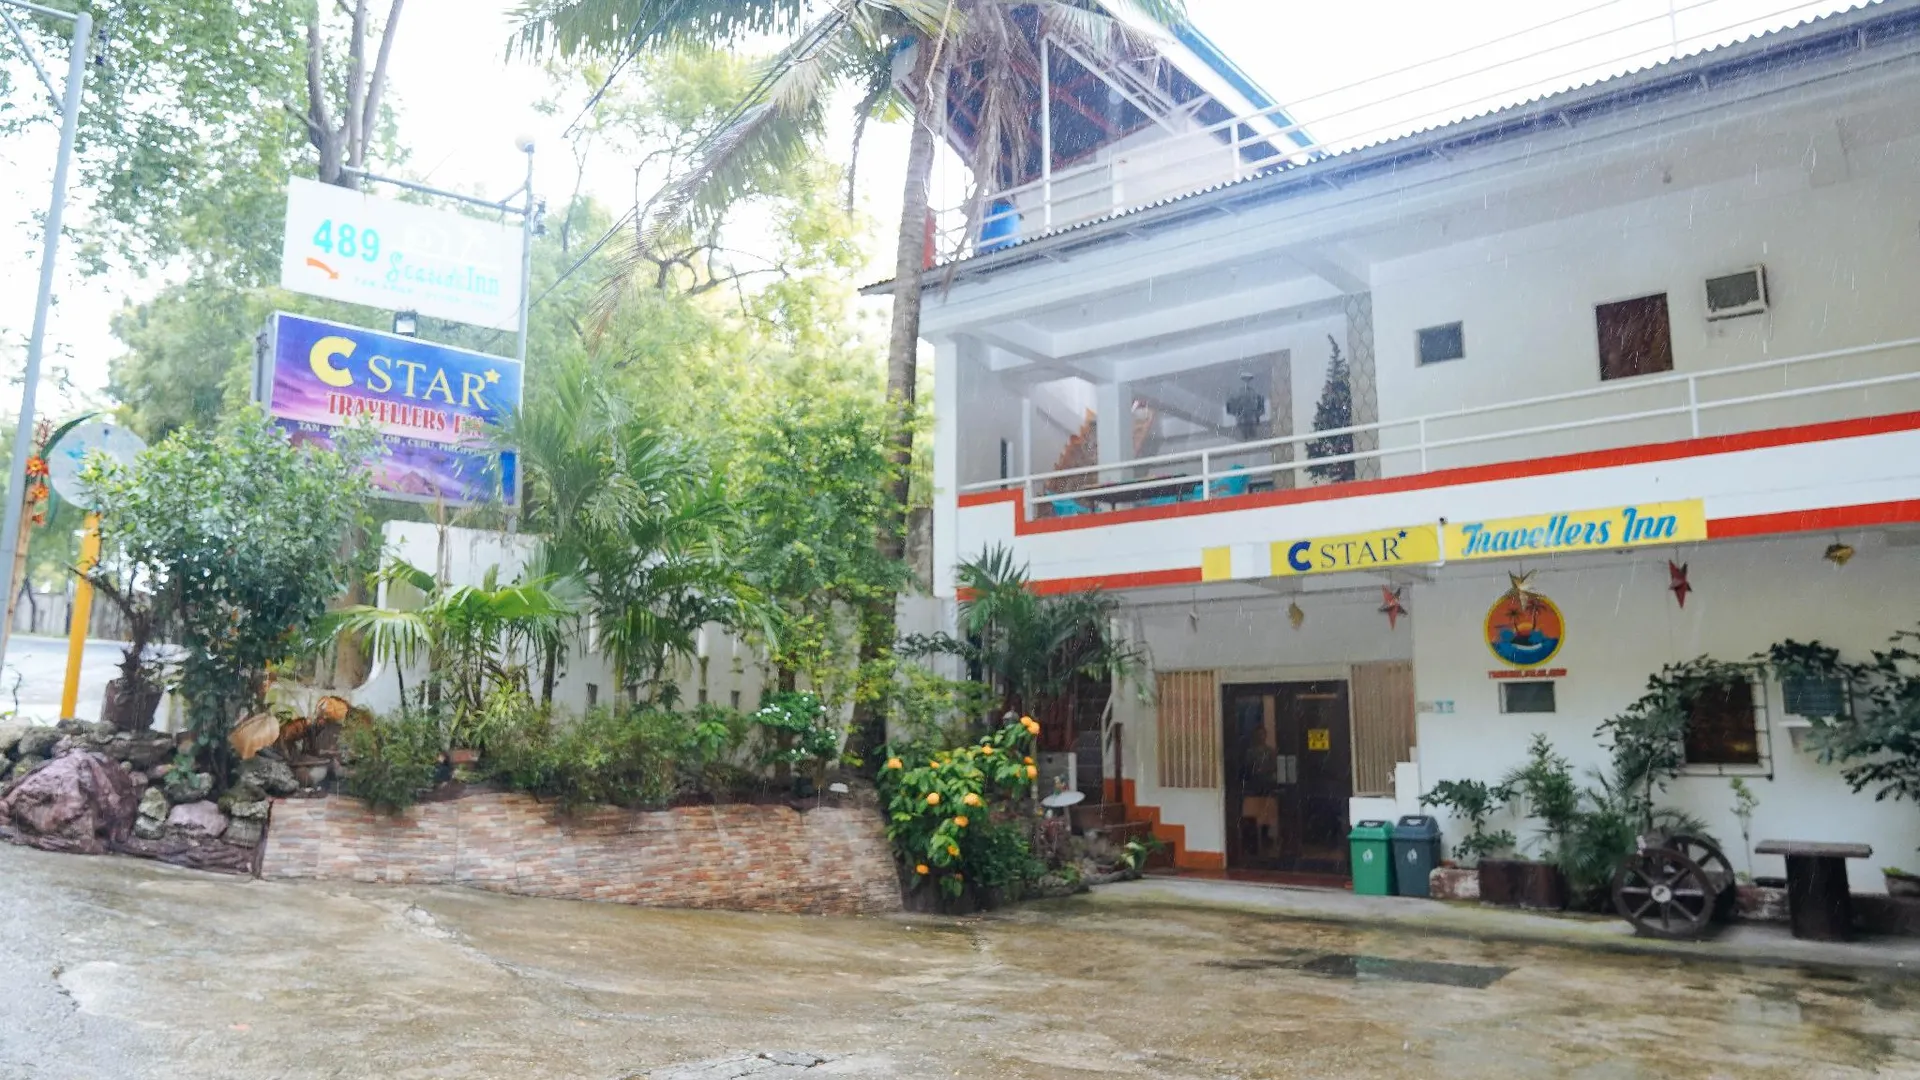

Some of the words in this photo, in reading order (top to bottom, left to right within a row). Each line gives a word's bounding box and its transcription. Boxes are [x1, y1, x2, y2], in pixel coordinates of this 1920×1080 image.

[312, 218, 381, 262] 489
[309, 335, 357, 387] C
[367, 354, 490, 411] STAR
[326, 391, 446, 432] TRAVELLERS
[1287, 541, 1312, 571] C
[1320, 536, 1403, 569] STAR
[1461, 513, 1612, 556] Travellers
[1622, 506, 1678, 543] Inn
